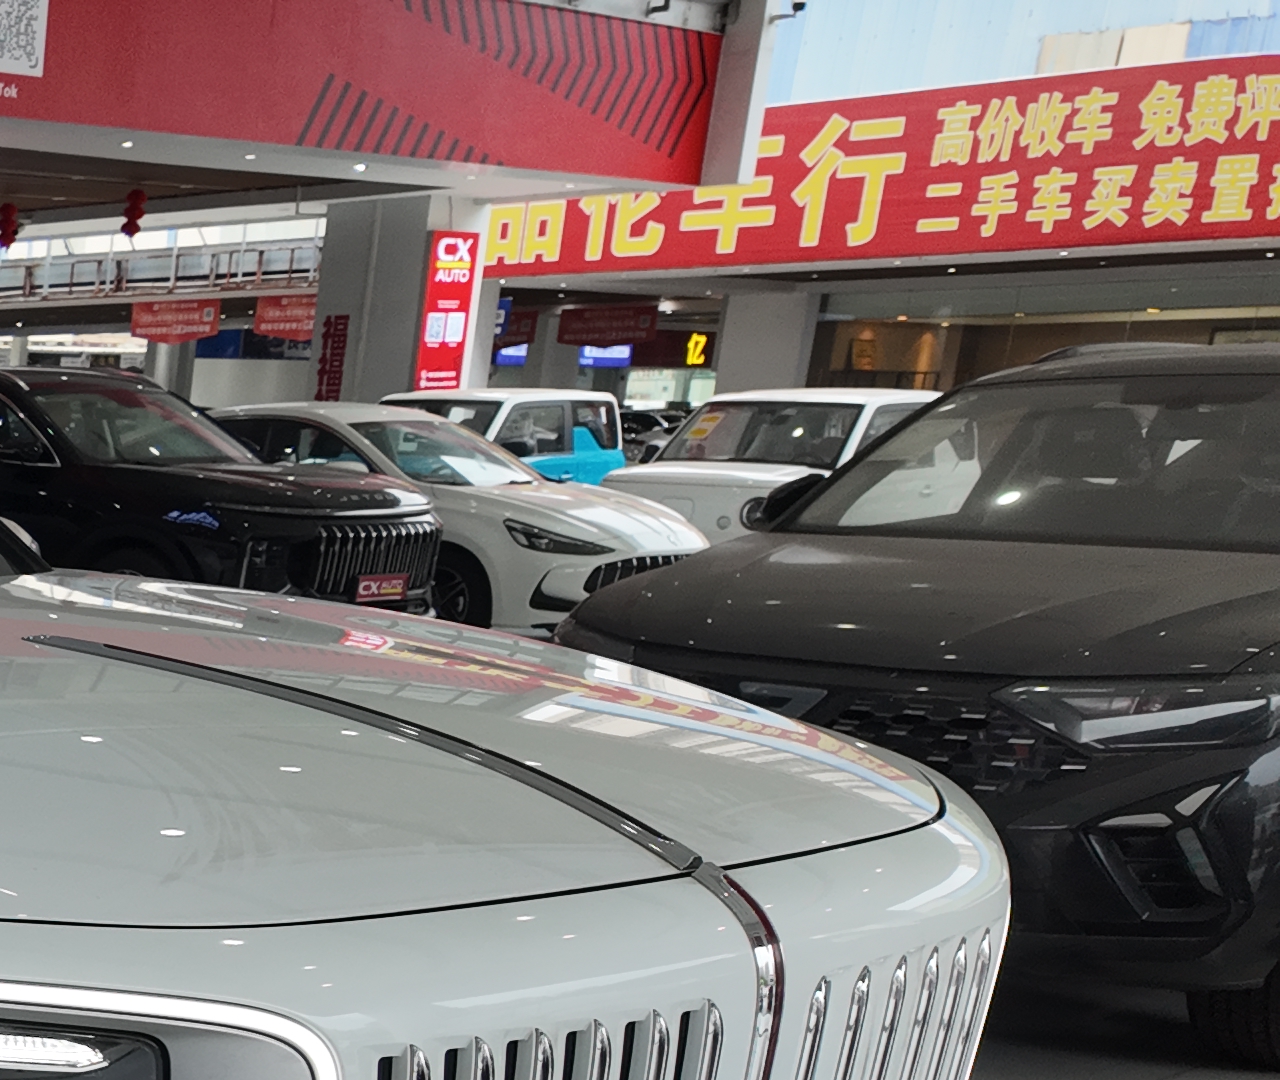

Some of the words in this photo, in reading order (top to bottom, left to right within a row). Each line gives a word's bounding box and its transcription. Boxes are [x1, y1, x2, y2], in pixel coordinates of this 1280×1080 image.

[929, 86, 1120, 167] 高价收车
[437, 237, 474, 262] CX
[434, 268, 470, 283] AUTO
[358, 581, 380, 595] CX
[381, 580, 403, 588] AUTO
